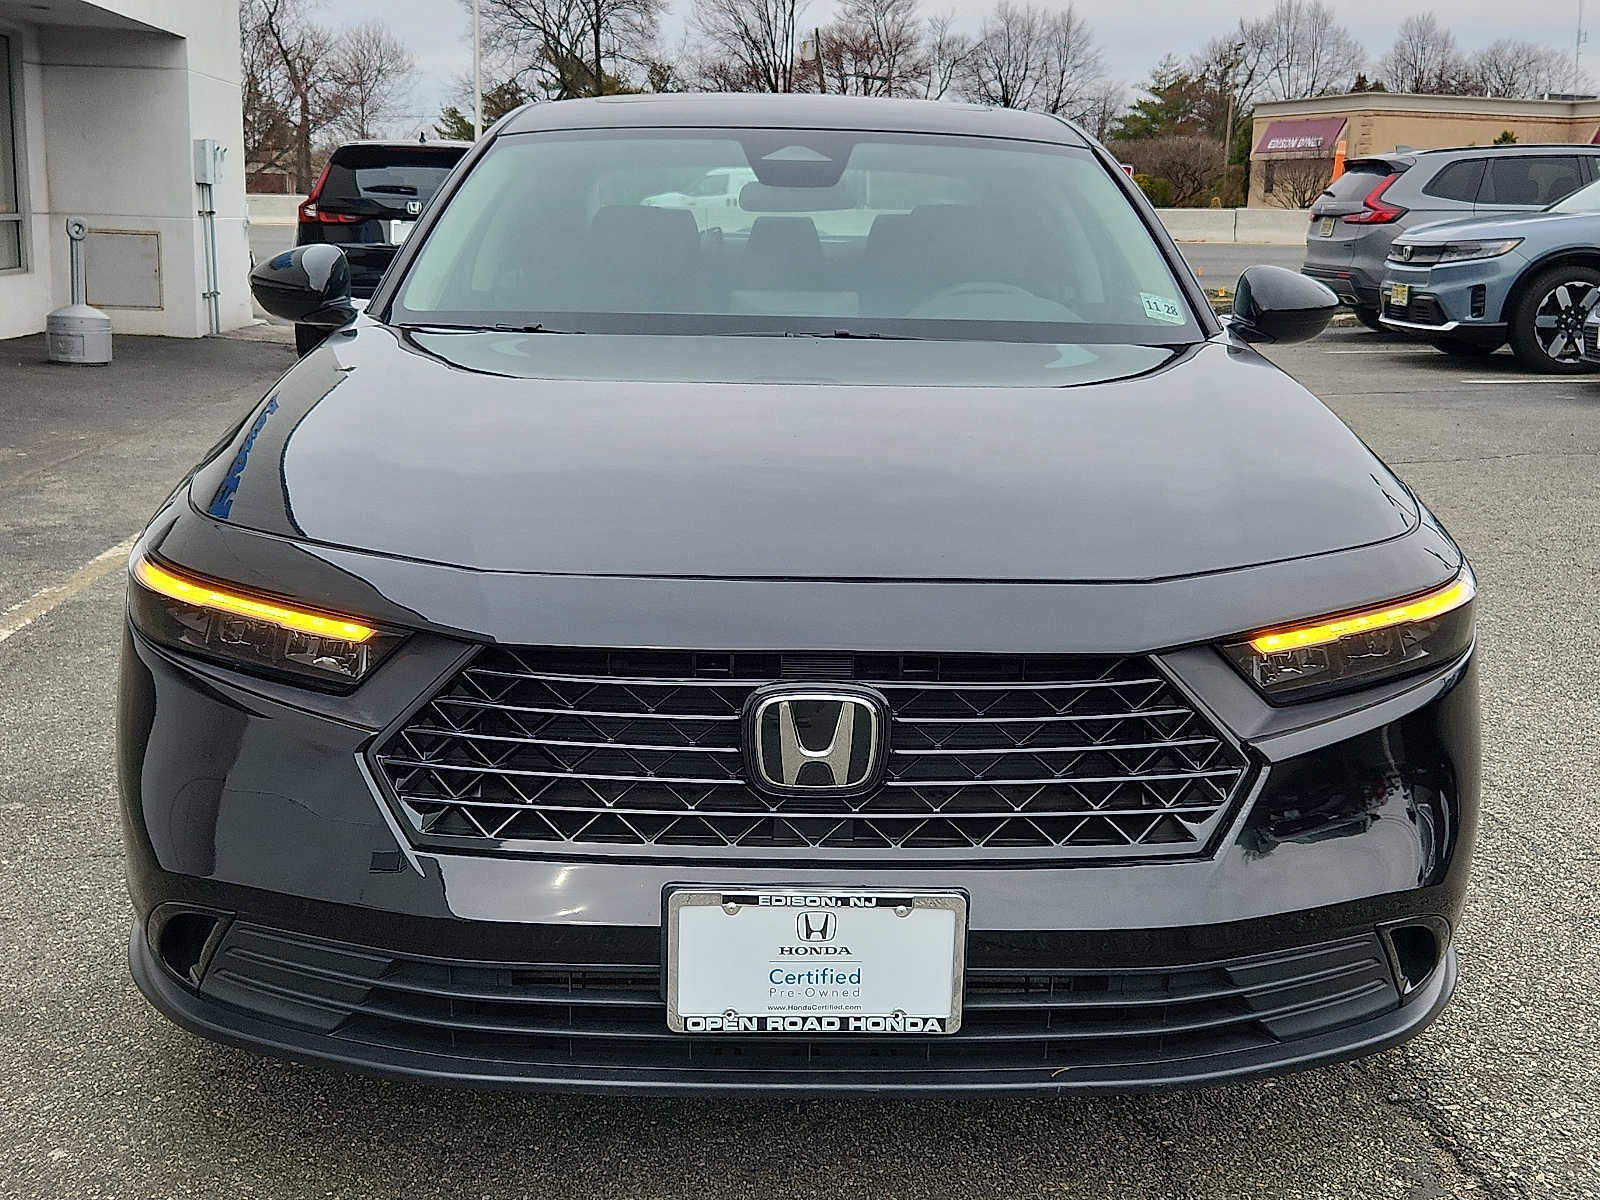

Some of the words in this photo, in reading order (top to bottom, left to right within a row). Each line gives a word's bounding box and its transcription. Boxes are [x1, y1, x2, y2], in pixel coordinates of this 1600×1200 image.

[758, 895, 842, 908] EDISON,
[849, 897, 877, 908] NJ
[778, 946, 852, 956] HONDA
[769, 967, 861, 985] Certified
[769, 987, 861, 998] Pre-Owned
[686, 1017, 758, 1032] OPEN
[766, 1017, 840, 1031] ROAD
[849, 1018, 942, 1032] HONDA
